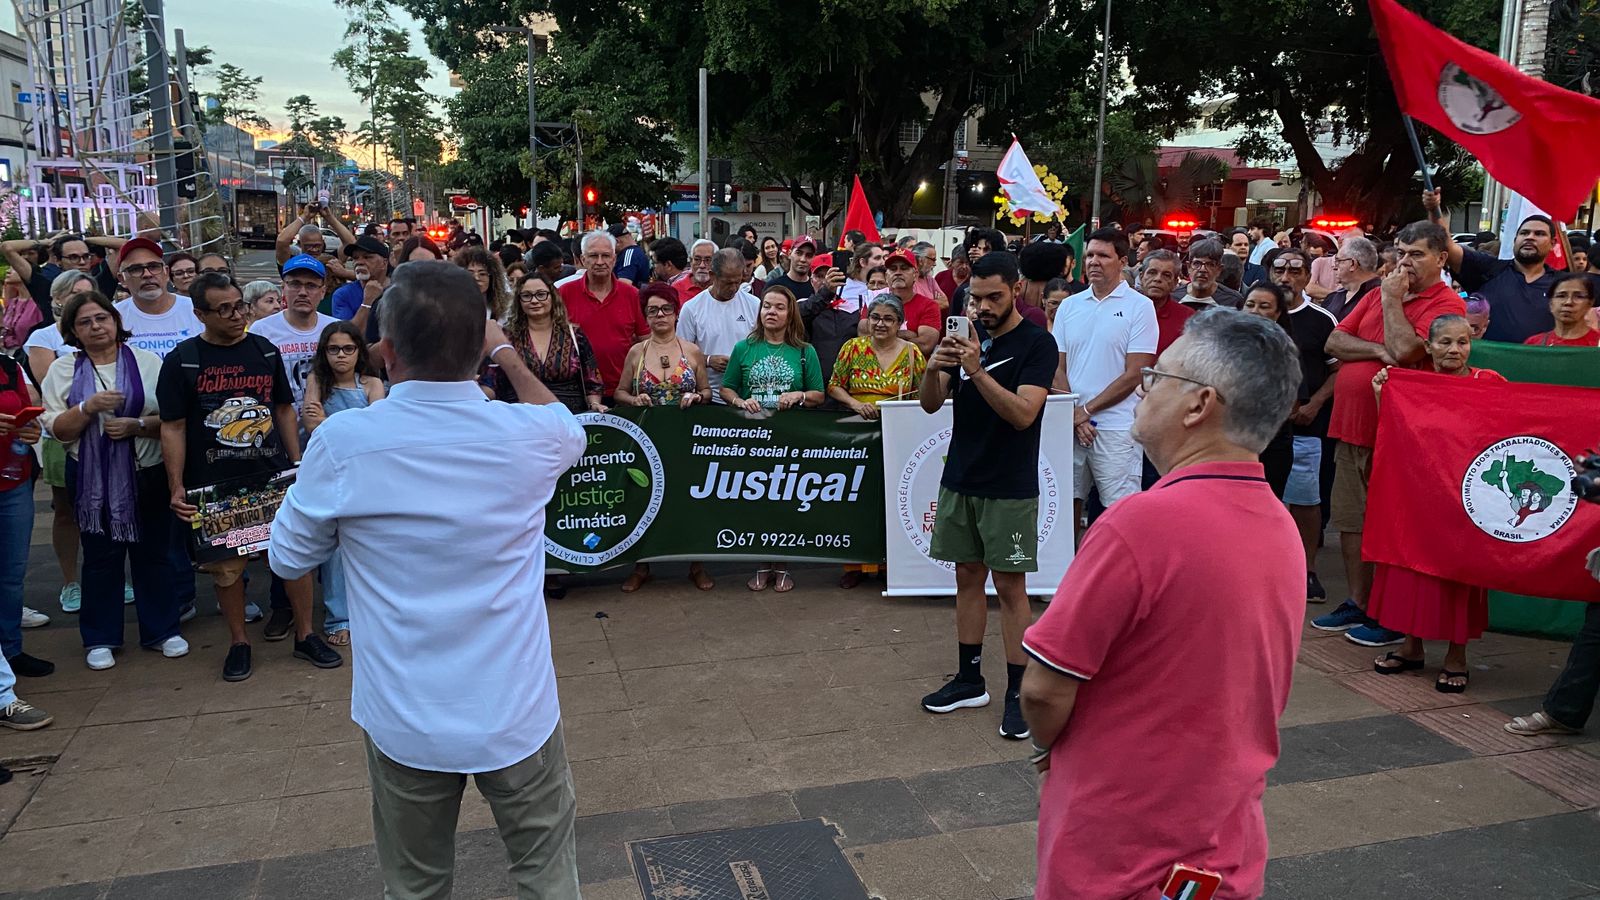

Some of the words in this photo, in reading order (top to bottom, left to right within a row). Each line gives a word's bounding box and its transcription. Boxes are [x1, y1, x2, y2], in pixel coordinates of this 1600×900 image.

[301, 342, 309, 352] DE
[204, 364, 246, 376] Vintage
[692, 424, 773, 441] Democracia;
[692, 443, 746, 457] inclusão
[750, 446, 789, 458] social
[790, 449, 799, 458] e
[802, 446, 869, 459] ambiental.
[914, 438, 936, 459] PELO
[571, 467, 607, 487] pela
[1043, 467, 1056, 497] MATO
[1464, 467, 1477, 514] MOVIMENTO
[1475, 452, 1491, 467] DOS
[1490, 437, 1561, 457] TRABALHADORES
[689, 461, 866, 512] Justiça!
[900, 460, 917, 531] EVANGÉLICOS
[557, 485, 625, 512] justiça
[556, 512, 627, 530] climática
[633, 515, 652, 538] PELA
[1037, 501, 1057, 543] GROSSO
[1549, 506, 1573, 530] TERRA
[737, 532, 756, 546] 67
[760, 533, 851, 548] 99224-0965
[910, 533, 923, 546] DE
[1493, 529, 1525, 540] BRASIL
[598, 536, 635, 562] JUSTIÇA
